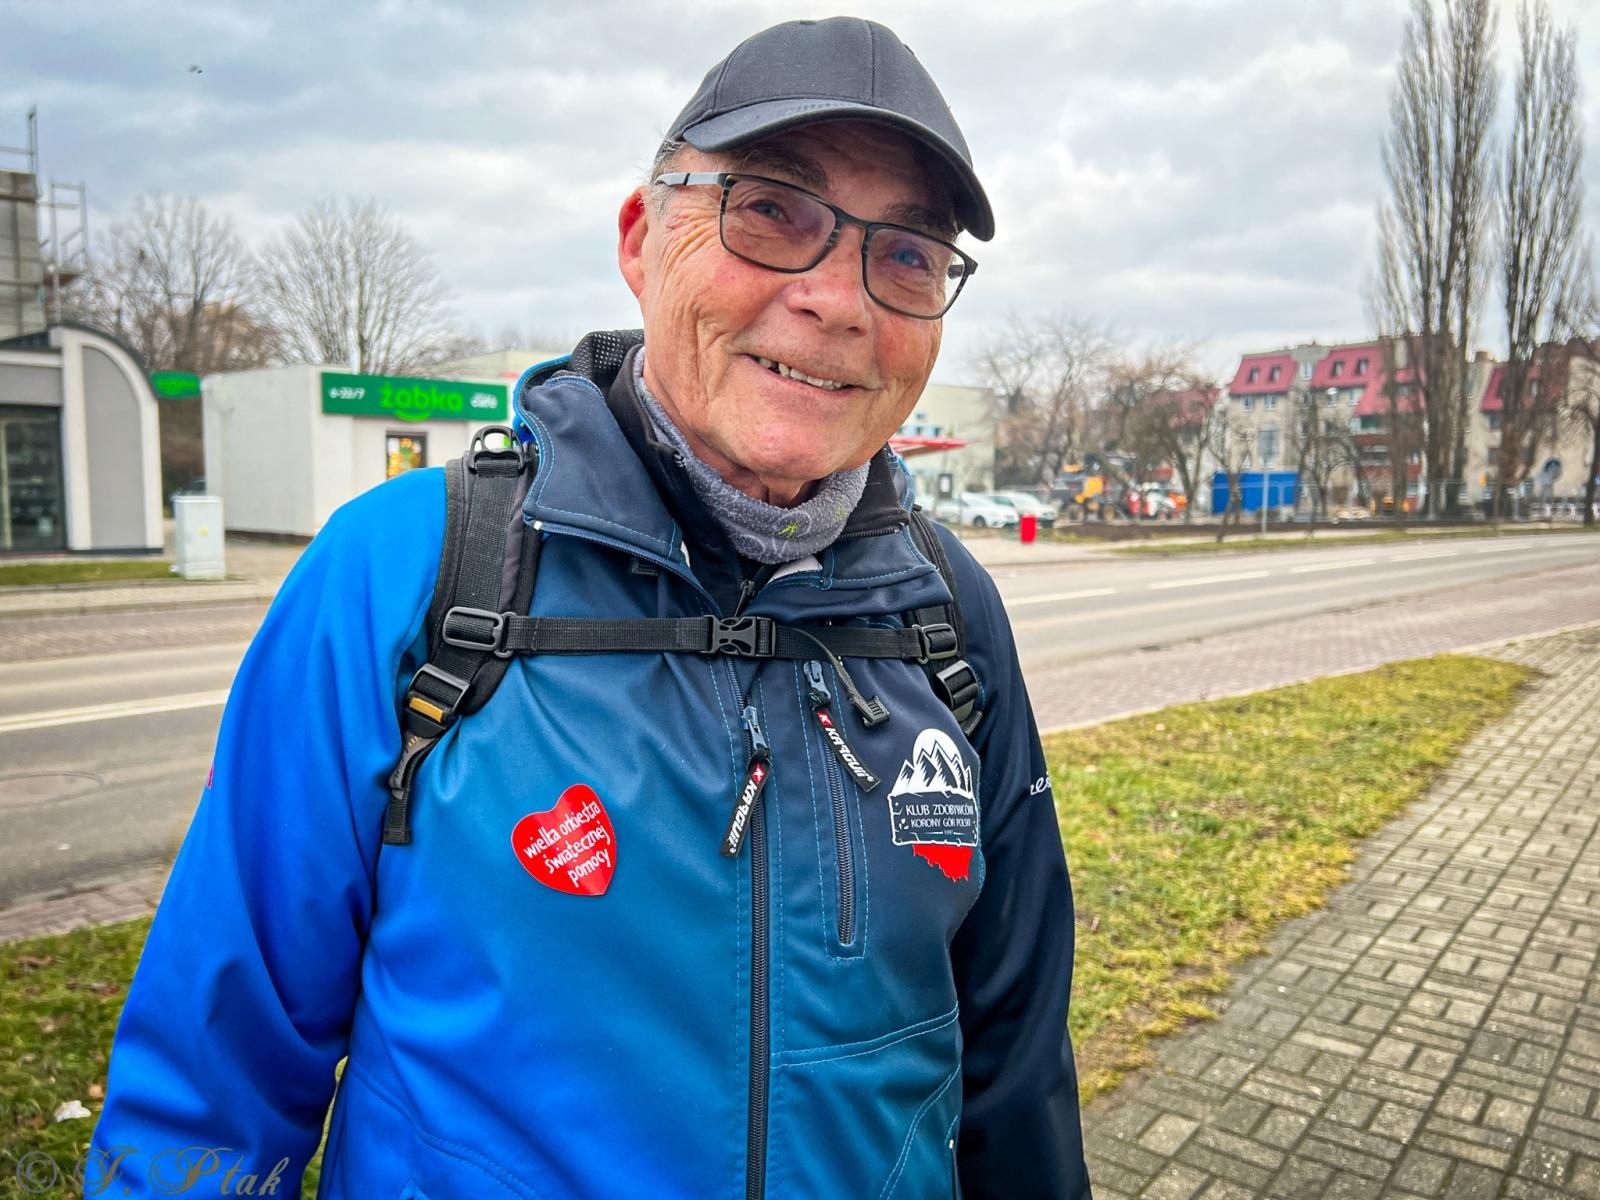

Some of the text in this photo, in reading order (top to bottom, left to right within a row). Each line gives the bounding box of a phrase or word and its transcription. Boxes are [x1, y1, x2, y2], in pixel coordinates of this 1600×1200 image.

[905, 804, 930, 816] KLUB
[910, 817, 941, 828] KORONY
[523, 800, 601, 859] wielka orkiestra
[567, 848, 611, 888] pomocy
